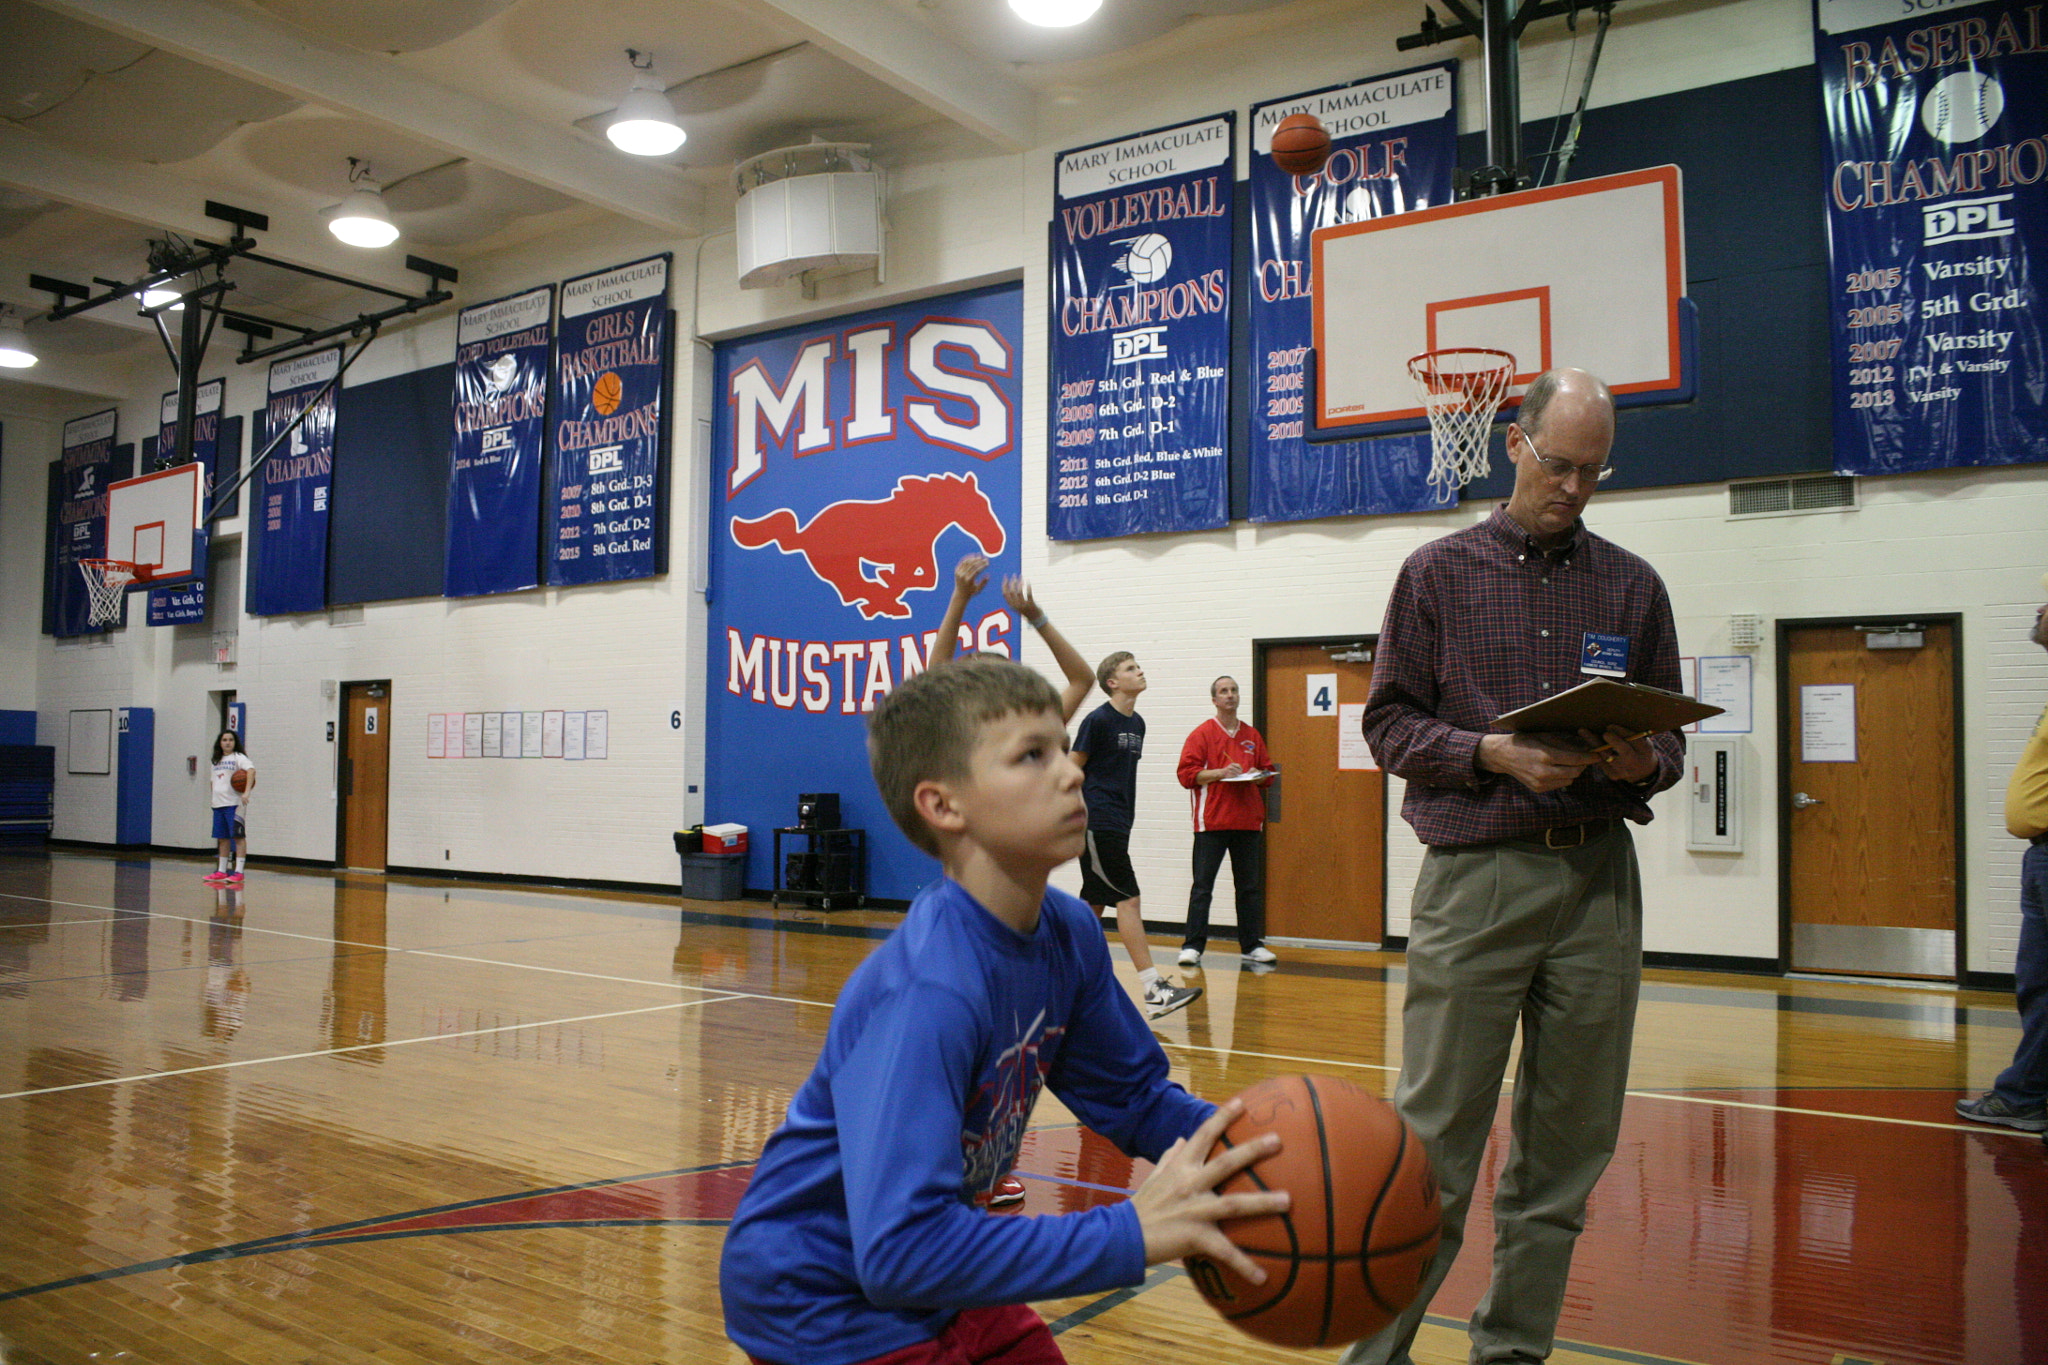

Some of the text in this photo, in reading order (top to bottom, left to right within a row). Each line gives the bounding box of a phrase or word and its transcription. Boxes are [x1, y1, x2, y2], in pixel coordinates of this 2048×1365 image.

[1319, 74, 1444, 114] IMMACULATE
[1327, 110, 1391, 135] CHOOL
[1065, 125, 1223, 174] MARY IMMACULATE
[1109, 158, 1176, 185] SCHOOL
[1833, 134, 2048, 212] CHAMPIO
[1062, 177, 1225, 245] VOLLEYBALL
[1923, 203, 2014, 239] DPL
[566, 263, 662, 298] MARY IMMACULATE
[1846, 255, 2011, 293] 2005 Varsity
[592, 289, 633, 309] SCHOOL
[1062, 269, 1224, 336] CHAMPIONS
[1847, 288, 2028, 329] 2005 5th Grd.
[586, 310, 635, 345] GIRLS
[487, 327, 549, 356] VOLLEYBALL
[1113, 333, 1167, 359] DPL
[1848, 329, 2014, 363] 2007 Varsity
[561, 332, 660, 385] BASKETBALL
[1062, 365, 1224, 399] 2007 5th Grd. Red & Blue
[1849, 366, 1895, 386] 2012
[1956, 359, 2011, 374] Varsity
[454, 386, 545, 433] CHAMPIONS
[727, 315, 1014, 502] MIS
[1099, 403, 1119, 417] 6th
[1123, 400, 1145, 414] Grd.
[1151, 396, 1176, 409] D-2
[1850, 387, 1962, 409] 2013 Varsity
[559, 401, 658, 451] CHAMPIONS
[1099, 427, 1119, 441] 7th
[1123, 423, 1145, 437] Grd.
[1151, 421, 1175, 434] D-1
[482, 431, 512, 449] DPL
[266, 446, 332, 485] CHAMPIONS
[589, 451, 623, 470] DPL
[1095, 458, 1111, 469] 5th
[1156, 450, 1180, 461] Blue
[1182, 449, 1191, 459] &
[1192, 447, 1223, 458] White
[591, 481, 605, 495] 8th
[609, 479, 631, 492] Grd.
[634, 475, 653, 488] D-3
[1095, 477, 1111, 487] 6th
[1133, 470, 1149, 482] D-2
[1151, 469, 1175, 480] Blue
[591, 501, 605, 515] 8th
[608, 498, 630, 511] Grd.
[634, 494, 652, 508] D-1
[1095, 494, 1111, 505] 8th
[1133, 489, 1149, 500] D-1
[593, 522, 606, 536] 7th
[609, 521, 631, 534] Grd.
[633, 517, 650, 530] D-2
[593, 543, 606, 556] 5th
[608, 541, 630, 554] Grd.
[632, 537, 651, 551] Red
[727, 608, 1011, 715] MUSTANS
[1313, 686, 1332, 711] 4
[119, 717, 129, 730] 10
[231, 715, 236, 729] 9
[367, 715, 374, 731] 8
[670, 710, 681, 730] 6
